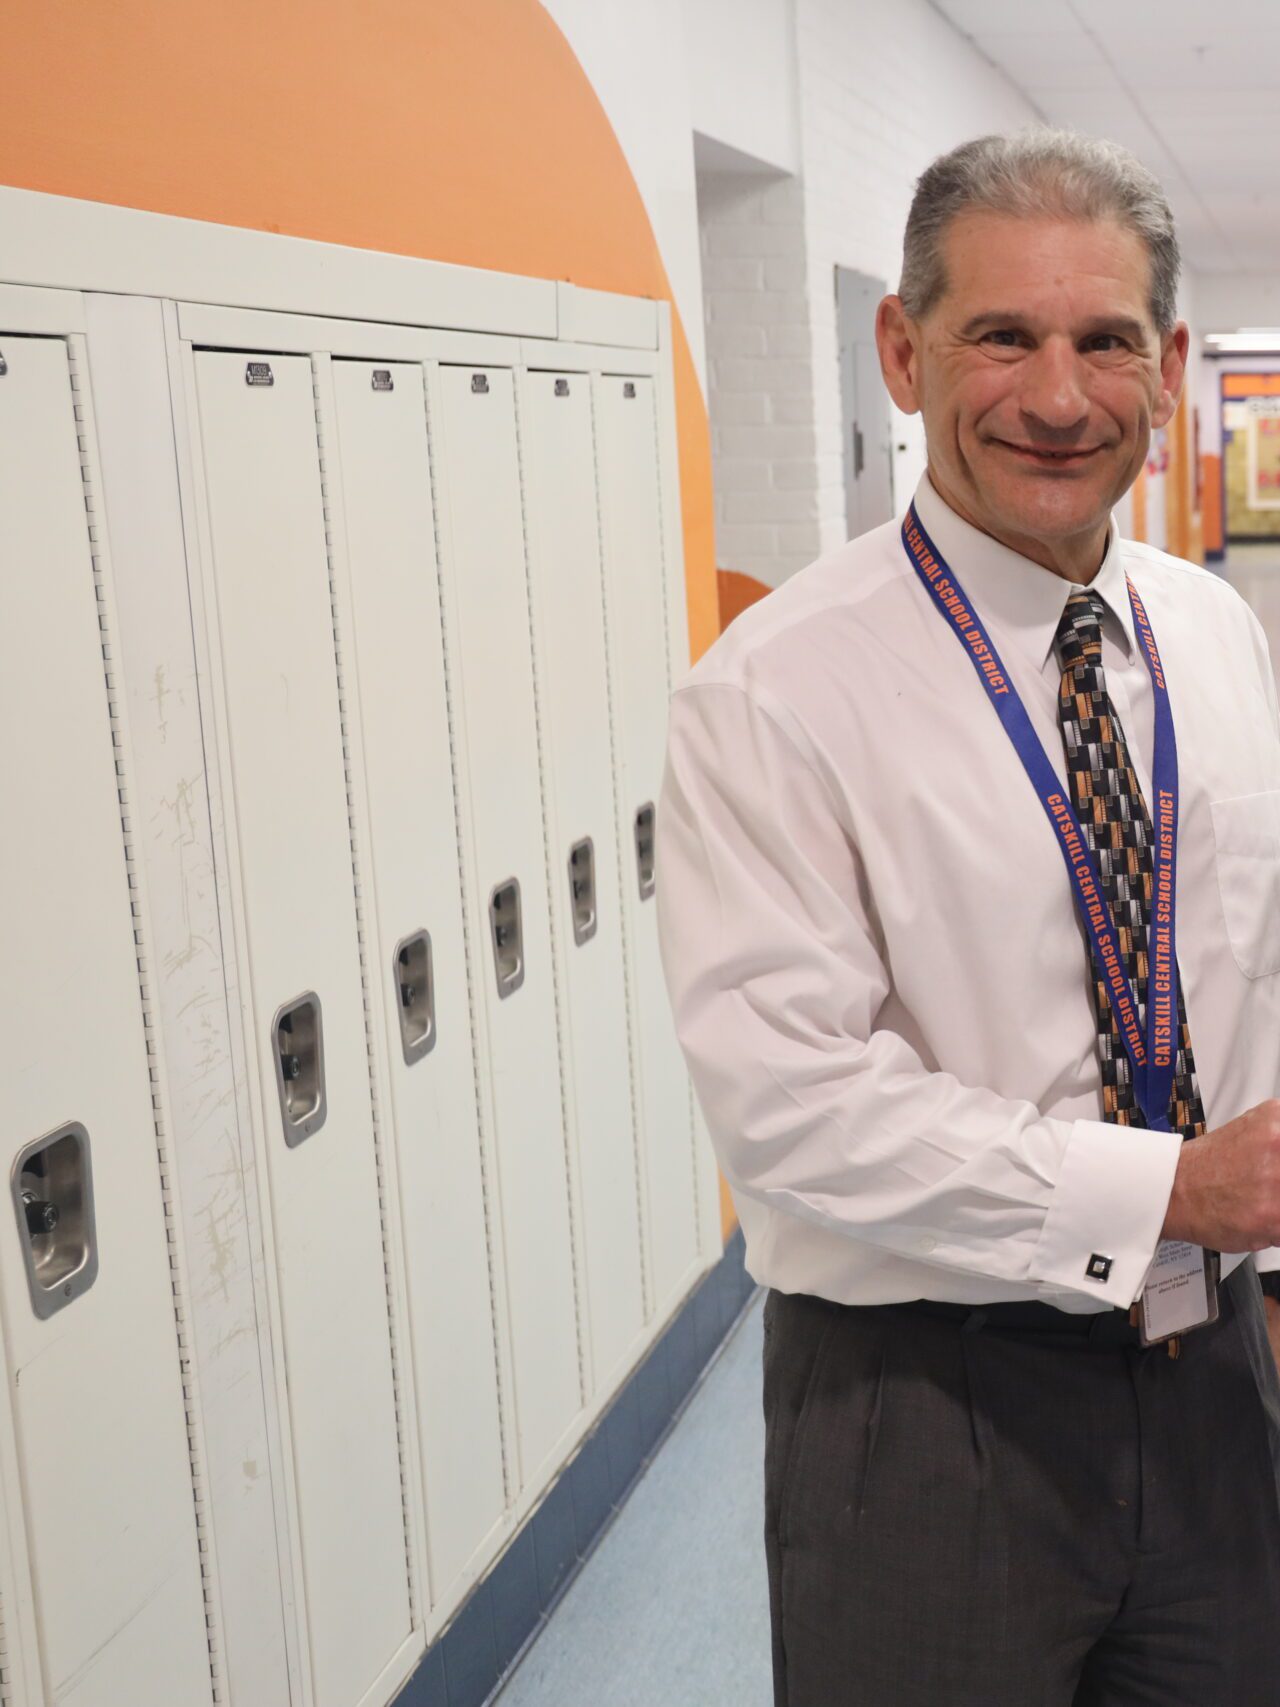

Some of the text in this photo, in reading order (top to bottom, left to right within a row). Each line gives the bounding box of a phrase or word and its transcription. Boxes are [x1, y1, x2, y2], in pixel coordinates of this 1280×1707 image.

[907, 527, 1010, 695] CENTRAL SCHOOL DISTRICT
[1141, 628, 1165, 690] CATSKILL
[1046, 793, 1148, 1068] CATSKILL CENTRAL SCHOOL DISTRICT
[1154, 790, 1174, 1068] CATSKILL CENTRAL SCHOOL DISTRICT
